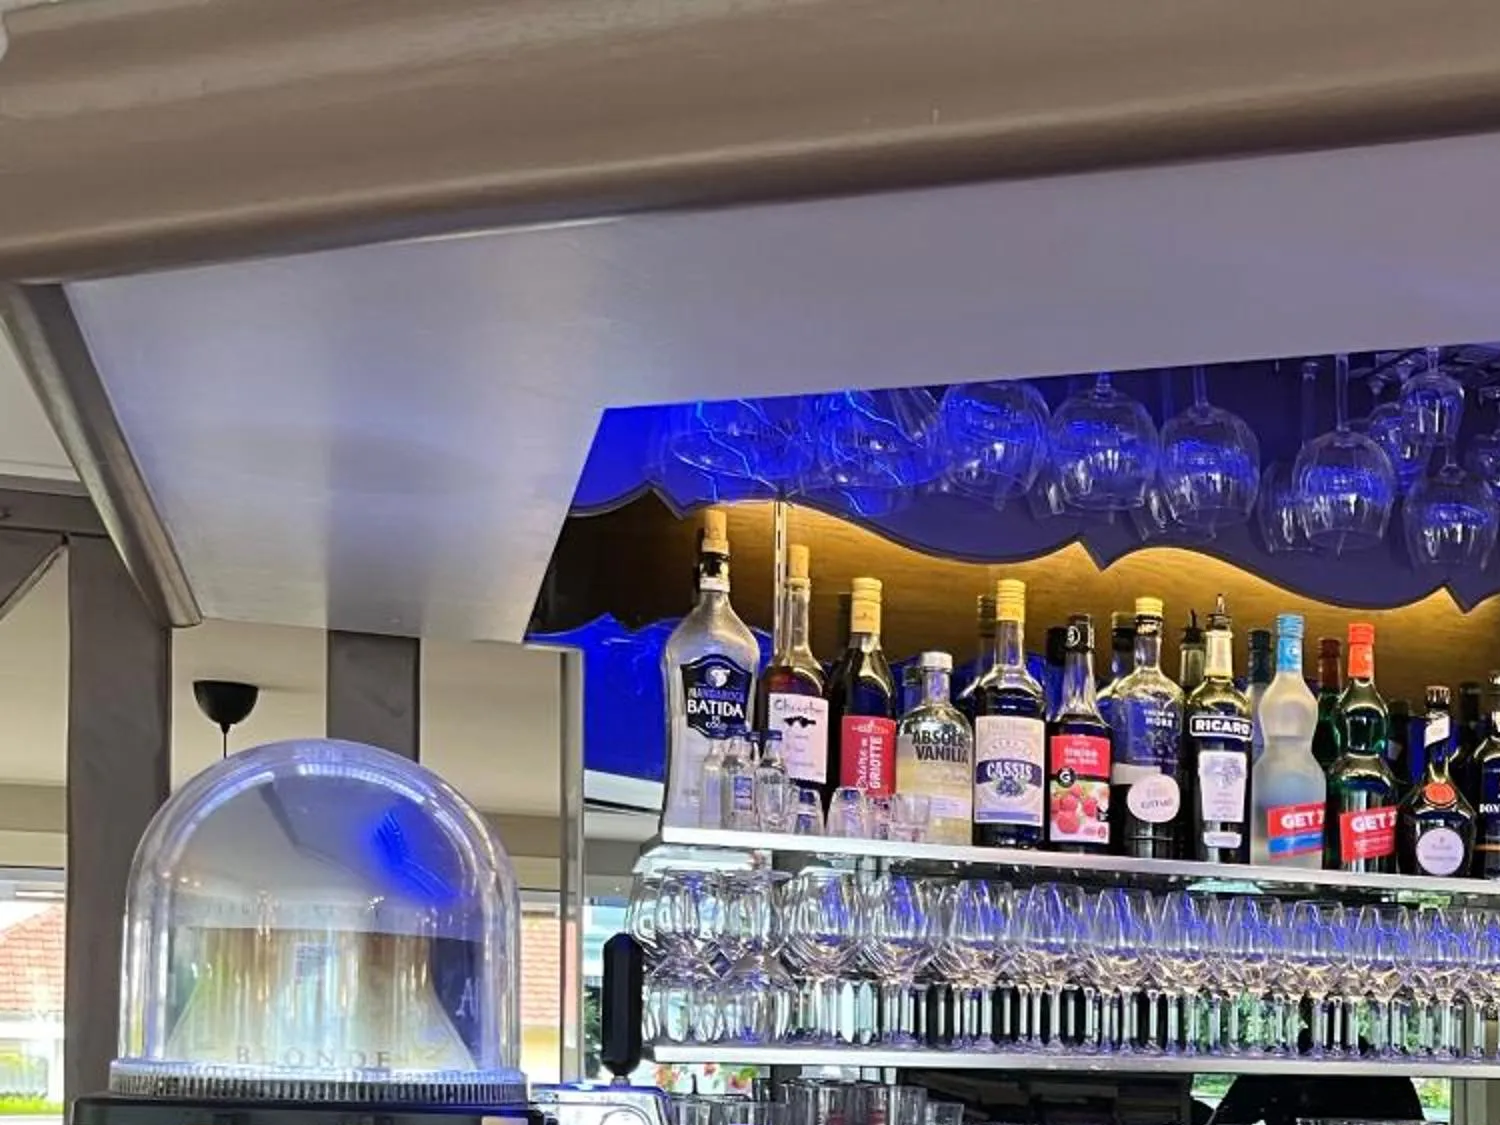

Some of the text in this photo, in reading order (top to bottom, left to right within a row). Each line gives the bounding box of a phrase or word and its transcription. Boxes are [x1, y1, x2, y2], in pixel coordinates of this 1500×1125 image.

[687, 700, 745, 718] BATIDA
[1195, 719, 1250, 735] RICARD
[869, 736, 883, 789] GRIOTTE
[986, 761, 1033, 778] CASSIS
[1280, 809, 1315, 829] GET
[1351, 813, 1387, 833] GET
